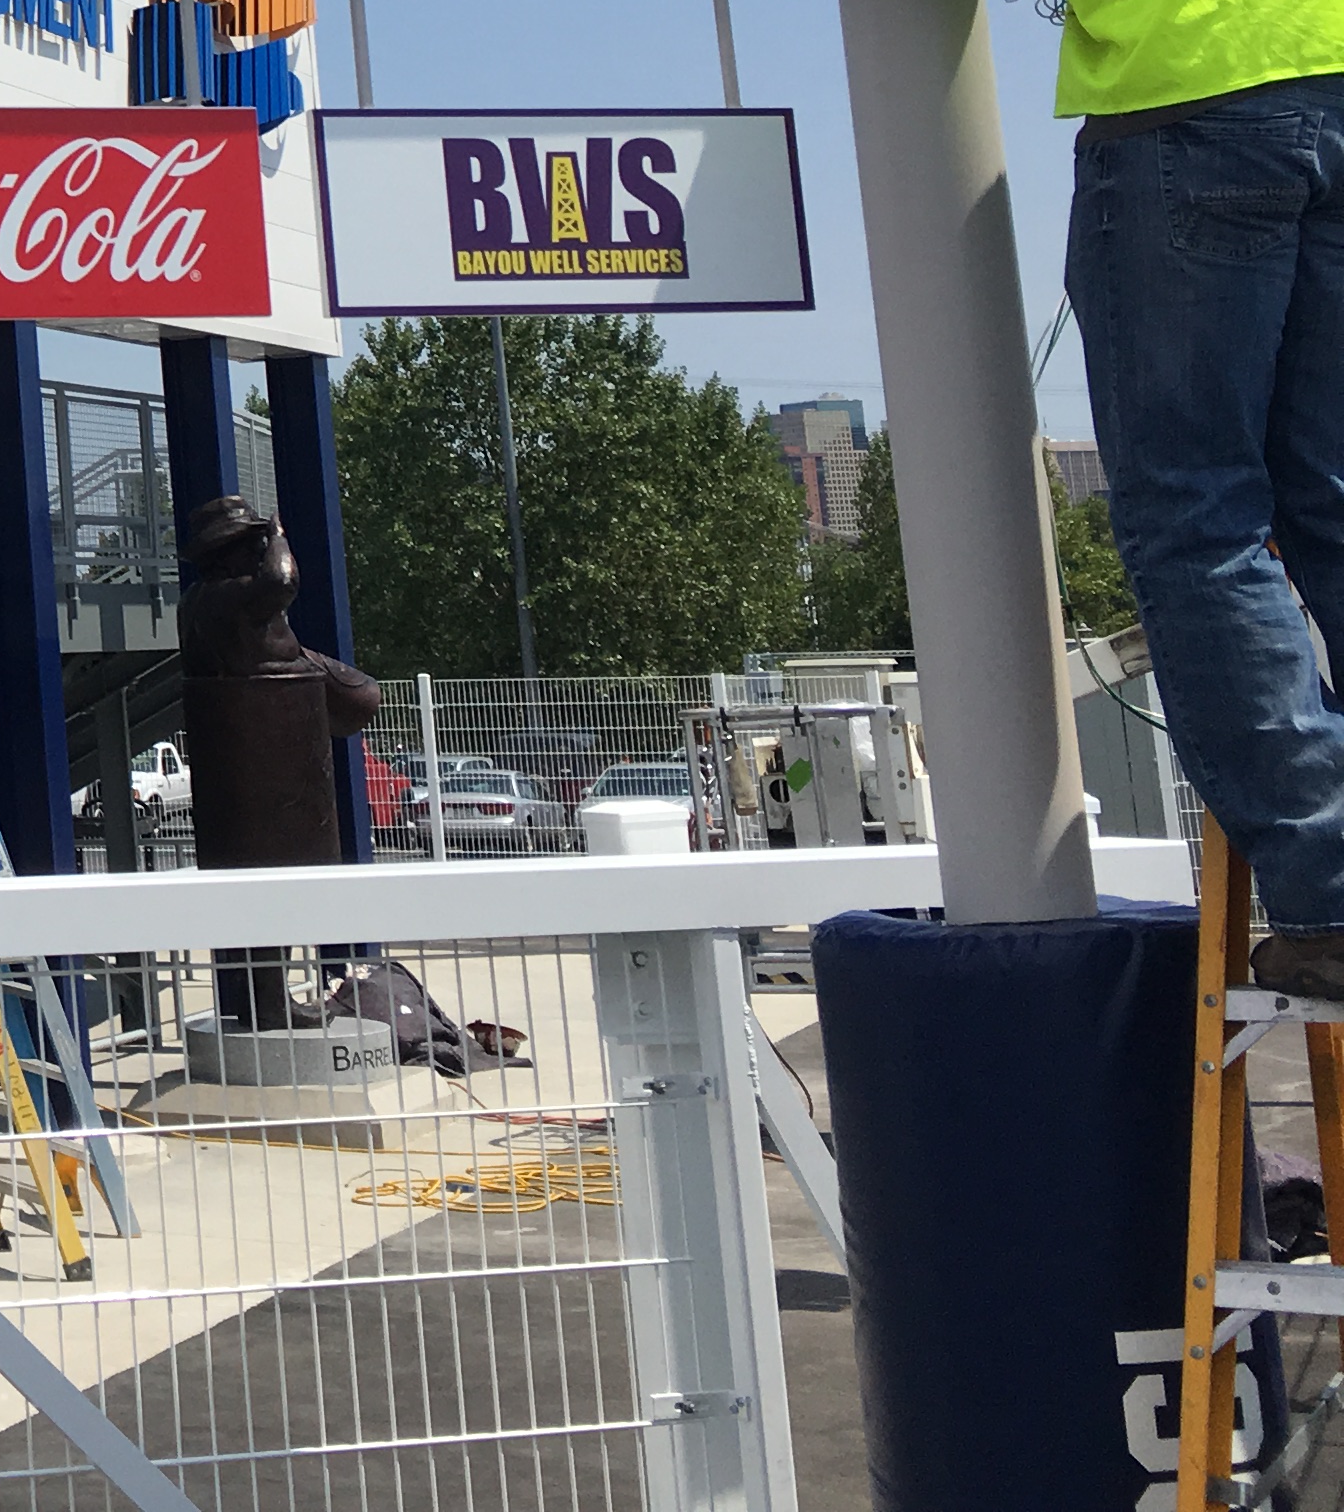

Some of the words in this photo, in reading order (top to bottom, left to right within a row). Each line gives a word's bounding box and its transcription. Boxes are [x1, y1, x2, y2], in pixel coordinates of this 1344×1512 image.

[442, 136, 686, 245] BWS
[457, 250, 527, 276] BAYOU
[529, 250, 584, 275] WELL
[586, 248, 684, 274] SERVICES
[332, 1046, 393, 1071] BARRE
